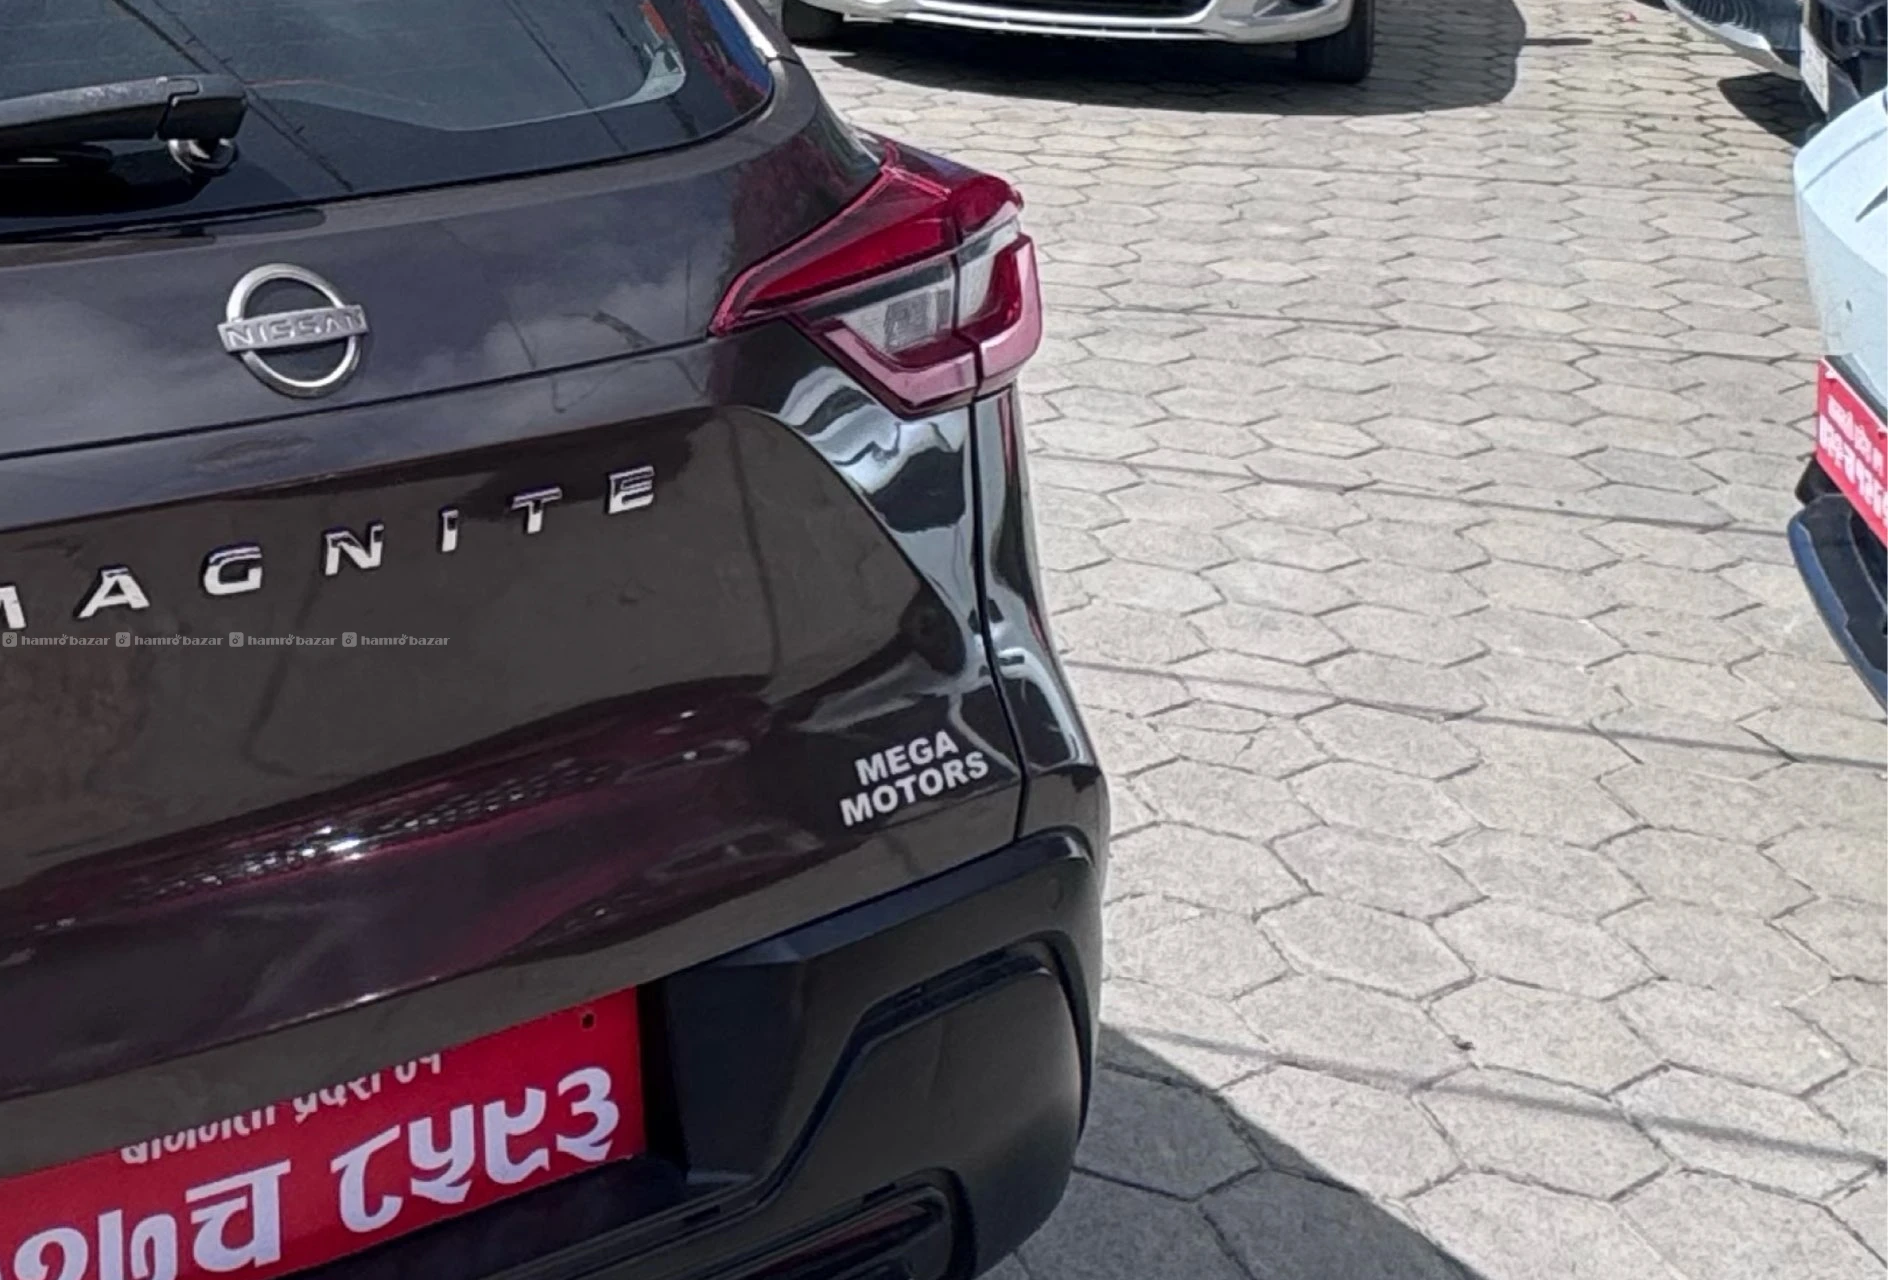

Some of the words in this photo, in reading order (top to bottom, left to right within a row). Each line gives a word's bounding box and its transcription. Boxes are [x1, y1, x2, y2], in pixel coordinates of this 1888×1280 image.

[225, 310, 366, 347] NISSAN
[855, 729, 959, 786] MEGA
[840, 751, 989, 826] MOTORS
